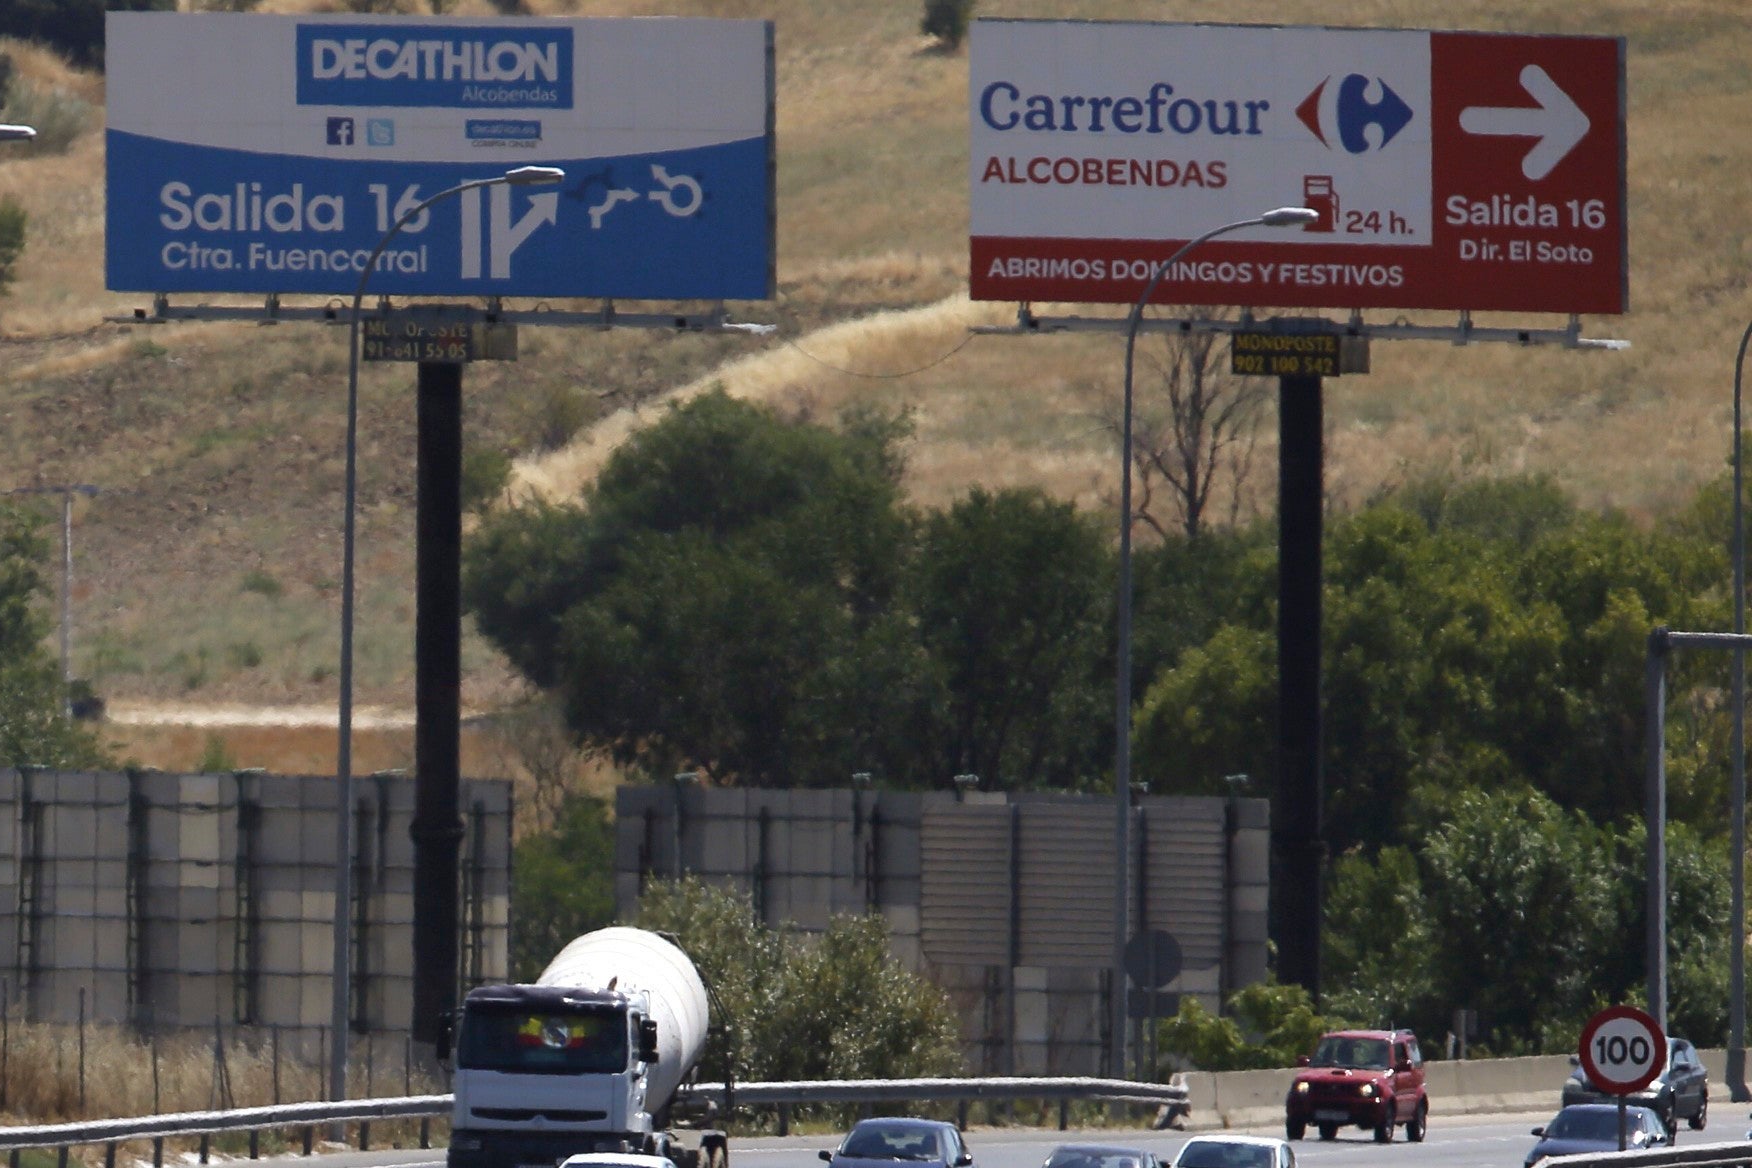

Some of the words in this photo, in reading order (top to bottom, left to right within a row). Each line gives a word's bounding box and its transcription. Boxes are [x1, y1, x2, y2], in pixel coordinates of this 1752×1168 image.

[312, 38, 558, 81] DECATHLON
[462, 86, 557, 101] Alcobendas
[980, 81, 1270, 135] Carrefour
[982, 156, 1227, 188] ALCOBENDAS
[159, 181, 345, 232] Salida
[368, 184, 430, 233] 16
[1345, 210, 1382, 234] 24
[1389, 210, 1414, 235] h.
[1446, 194, 1558, 227] Salida
[1566, 199, 1606, 229] 16
[161, 241, 242, 270] Ctra.
[249, 242, 427, 273] Fuencarral
[1460, 238, 1504, 261] Dir.
[1509, 240, 1530, 261] El
[1536, 241, 1593, 263] Soto
[988, 258, 1105, 280] ABRIMOS
[1111, 260, 1251, 282] DOMINGOS
[1258, 263, 1275, 282] Y
[1280, 263, 1403, 286] FESTIVOS
[1236, 334, 1336, 352] MONOPOSTE
[1596, 1035, 1650, 1065] 100
